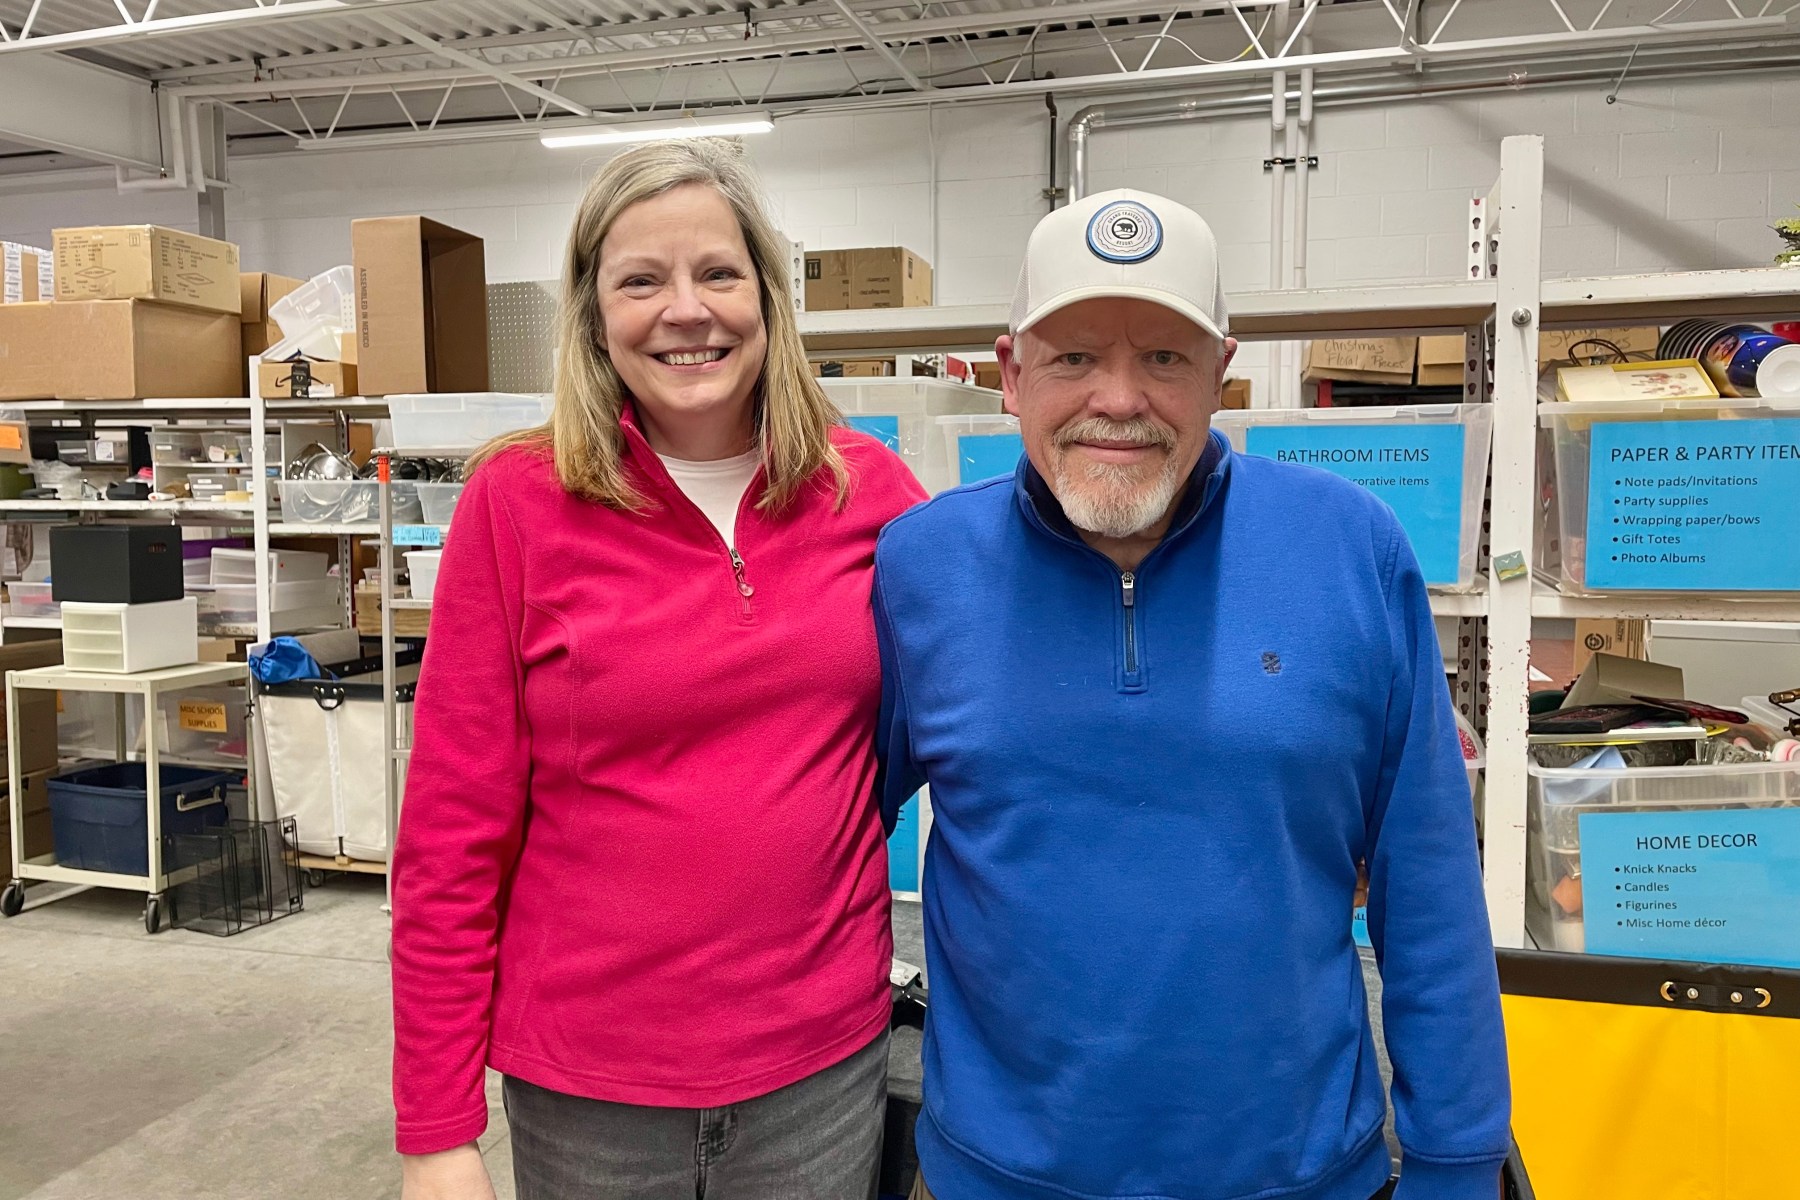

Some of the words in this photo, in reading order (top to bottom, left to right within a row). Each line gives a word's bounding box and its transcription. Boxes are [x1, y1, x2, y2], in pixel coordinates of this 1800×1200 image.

[360, 268, 368, 310] ASSEMBLED
[362, 311, 369, 320] IN
[362, 321, 370, 348] MEXICO
[1324, 339, 1385, 354] Christmas
[1277, 449, 1373, 463] BATHROOM
[1379, 448, 1430, 463] ITEMS
[1611, 447, 1669, 462] PAPER
[1675, 446, 1690, 461] &
[1696, 445, 1756, 461] PARTY
[1624, 477, 1654, 487] Note
[1657, 475, 1758, 489] pads/Invitations
[1623, 496, 1656, 508] Party
[1658, 495, 1709, 508] supplies
[1622, 514, 1682, 527] Wrapping
[1685, 514, 1761, 527] paper/bows
[1621, 534, 1644, 544] Gift
[1647, 534, 1681, 544] Totes
[1620, 553, 1657, 564] Photo
[1660, 552, 1706, 564] Albums
[197, 705, 223, 715] SCHOOL
[187, 719, 217, 728] SUPPLIES
[1636, 836, 1692, 850] HOME
[1697, 833, 1757, 848] DECOR
[1623, 864, 1654, 874] Knick
[1657, 863, 1697, 873] Knacks
[1624, 882, 1670, 892] Candles
[1625, 900, 1678, 911] Figurines
[1626, 918, 1653, 928] Misc
[1656, 918, 1691, 928] Home
[1694, 917, 1727, 928] décor
